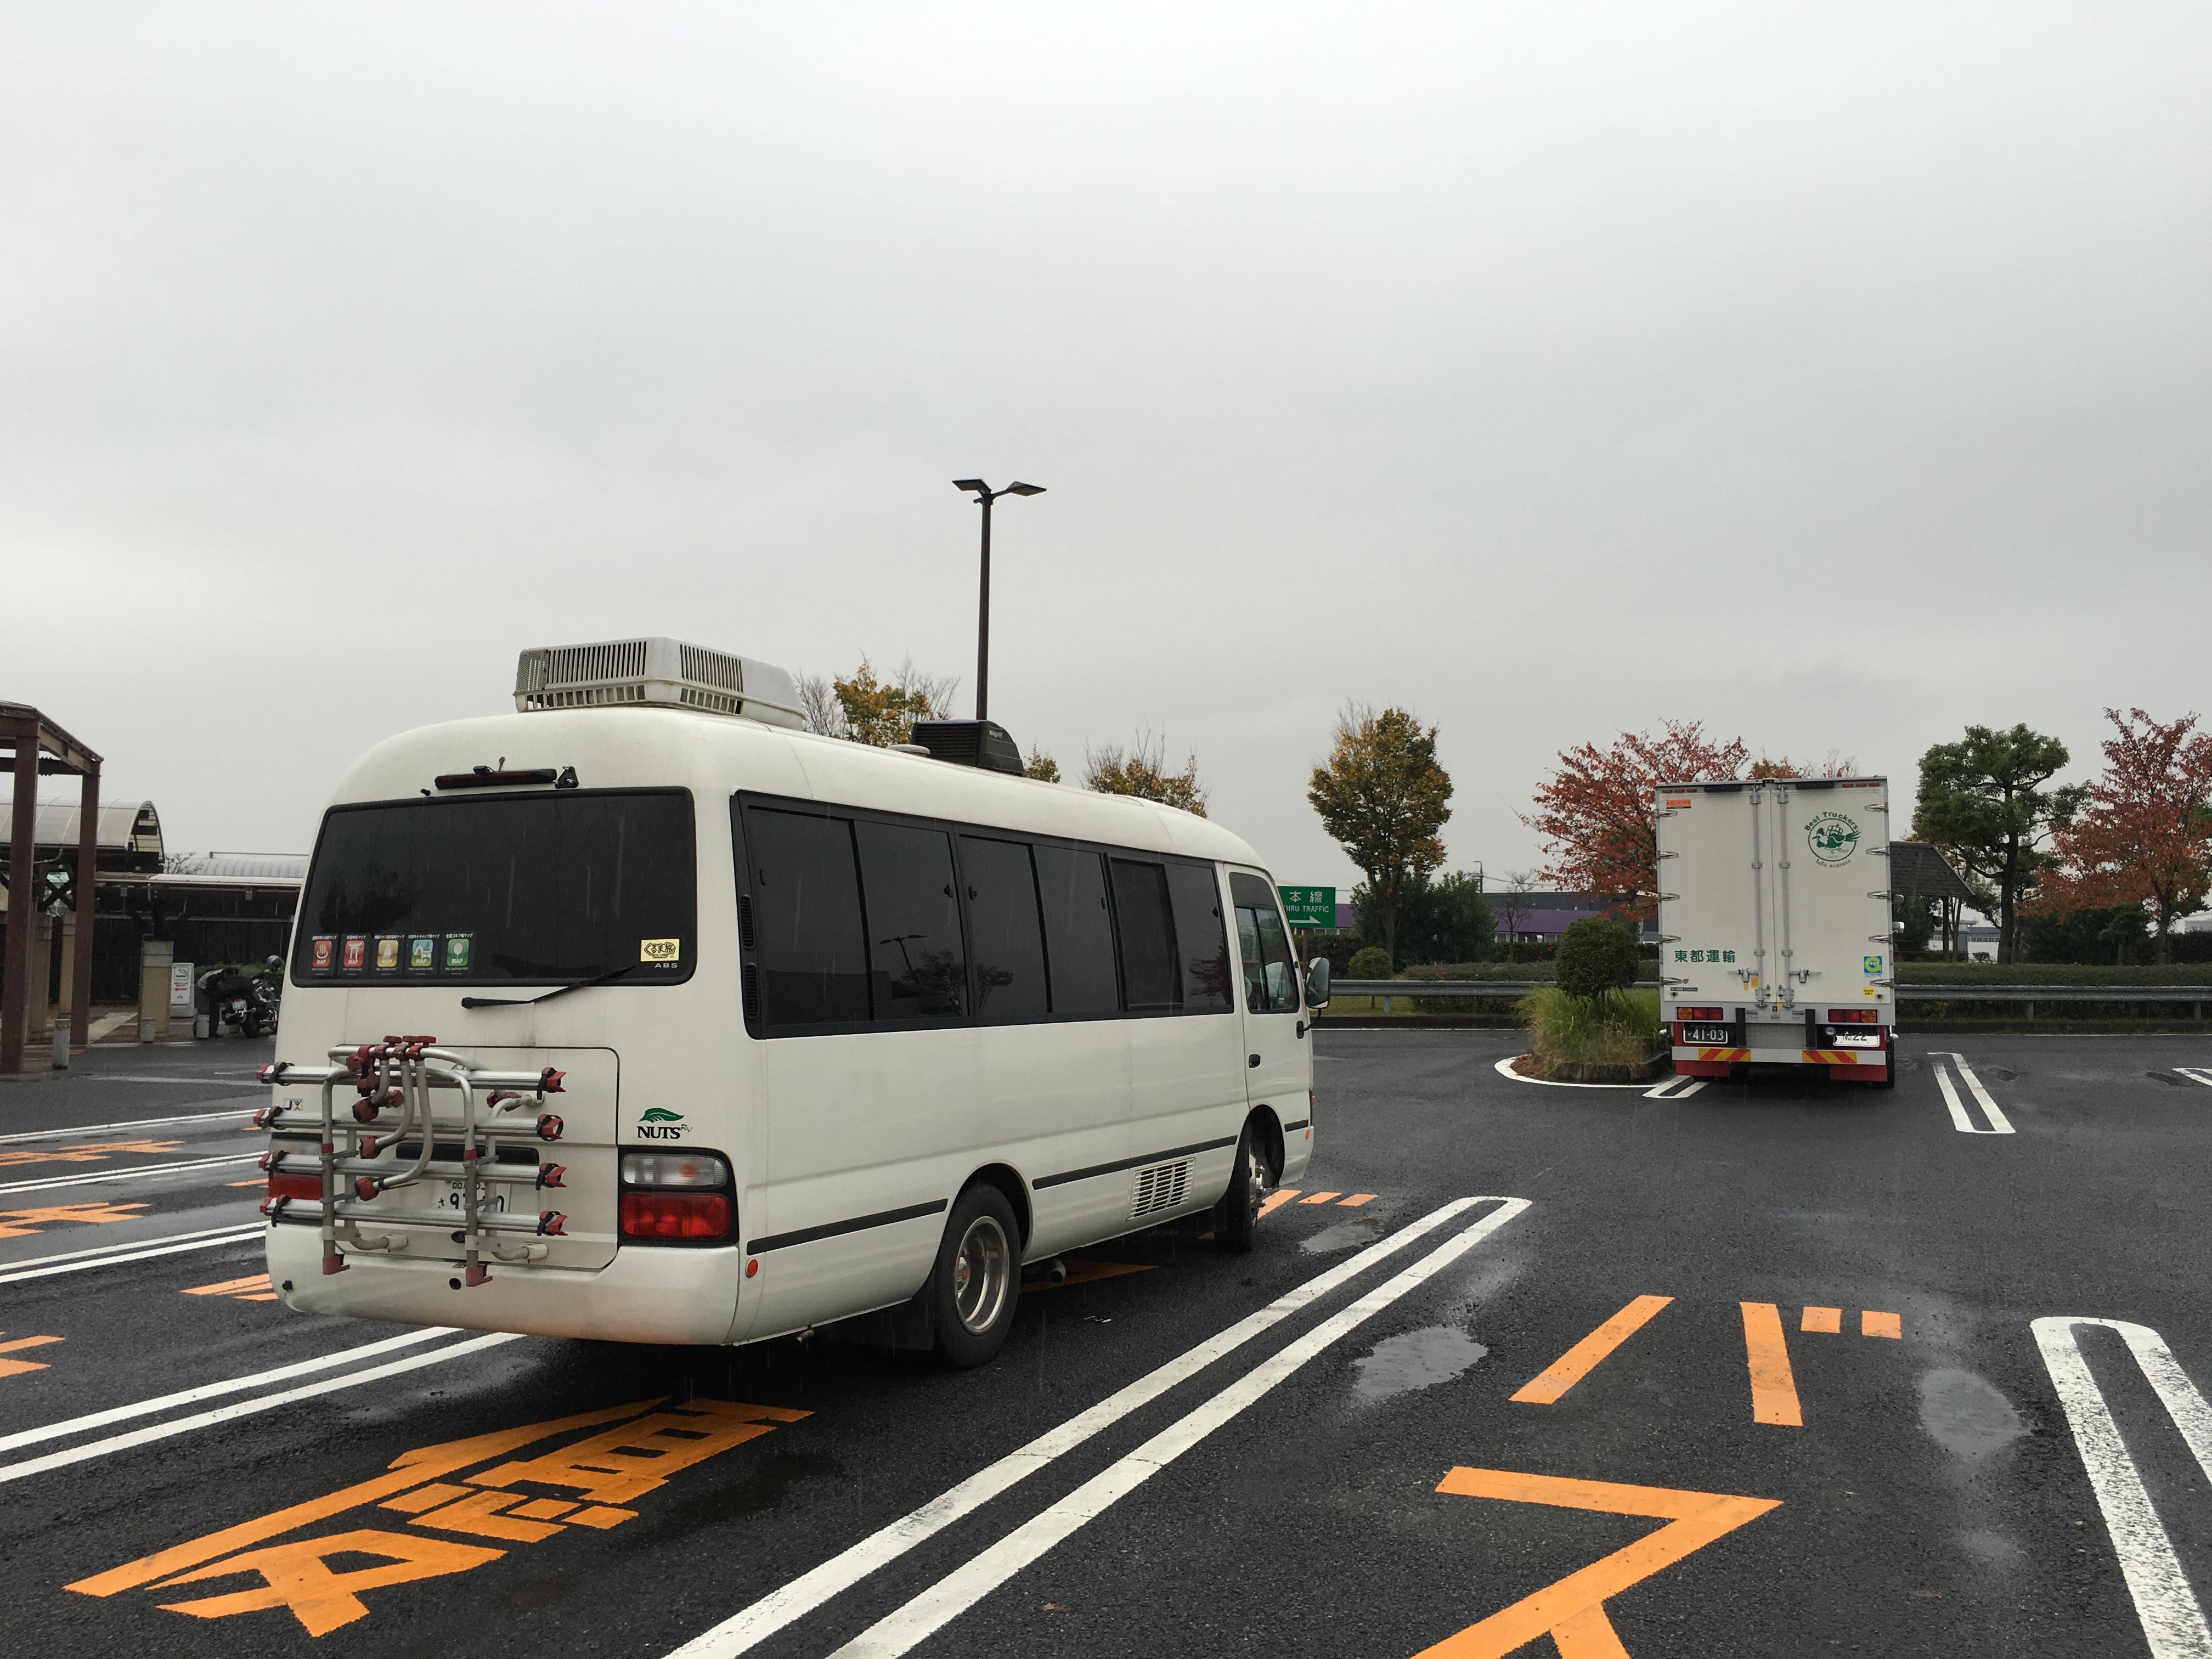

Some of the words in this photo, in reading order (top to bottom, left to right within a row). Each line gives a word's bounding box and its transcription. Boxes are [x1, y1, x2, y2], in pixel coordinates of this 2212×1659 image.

[1804, 815, 1820, 831] Best
[1822, 812, 1859, 830] Truckers
[1829, 859, 1852, 868] express
[1289, 890, 1323, 903] 本線
[644, 942, 676, 955] くるま旅
[1674, 950, 1736, 963] 東都運輸
[1692, 1029, 1724, 1041] 41-03
[637, 1126, 681, 1139] NUTS
